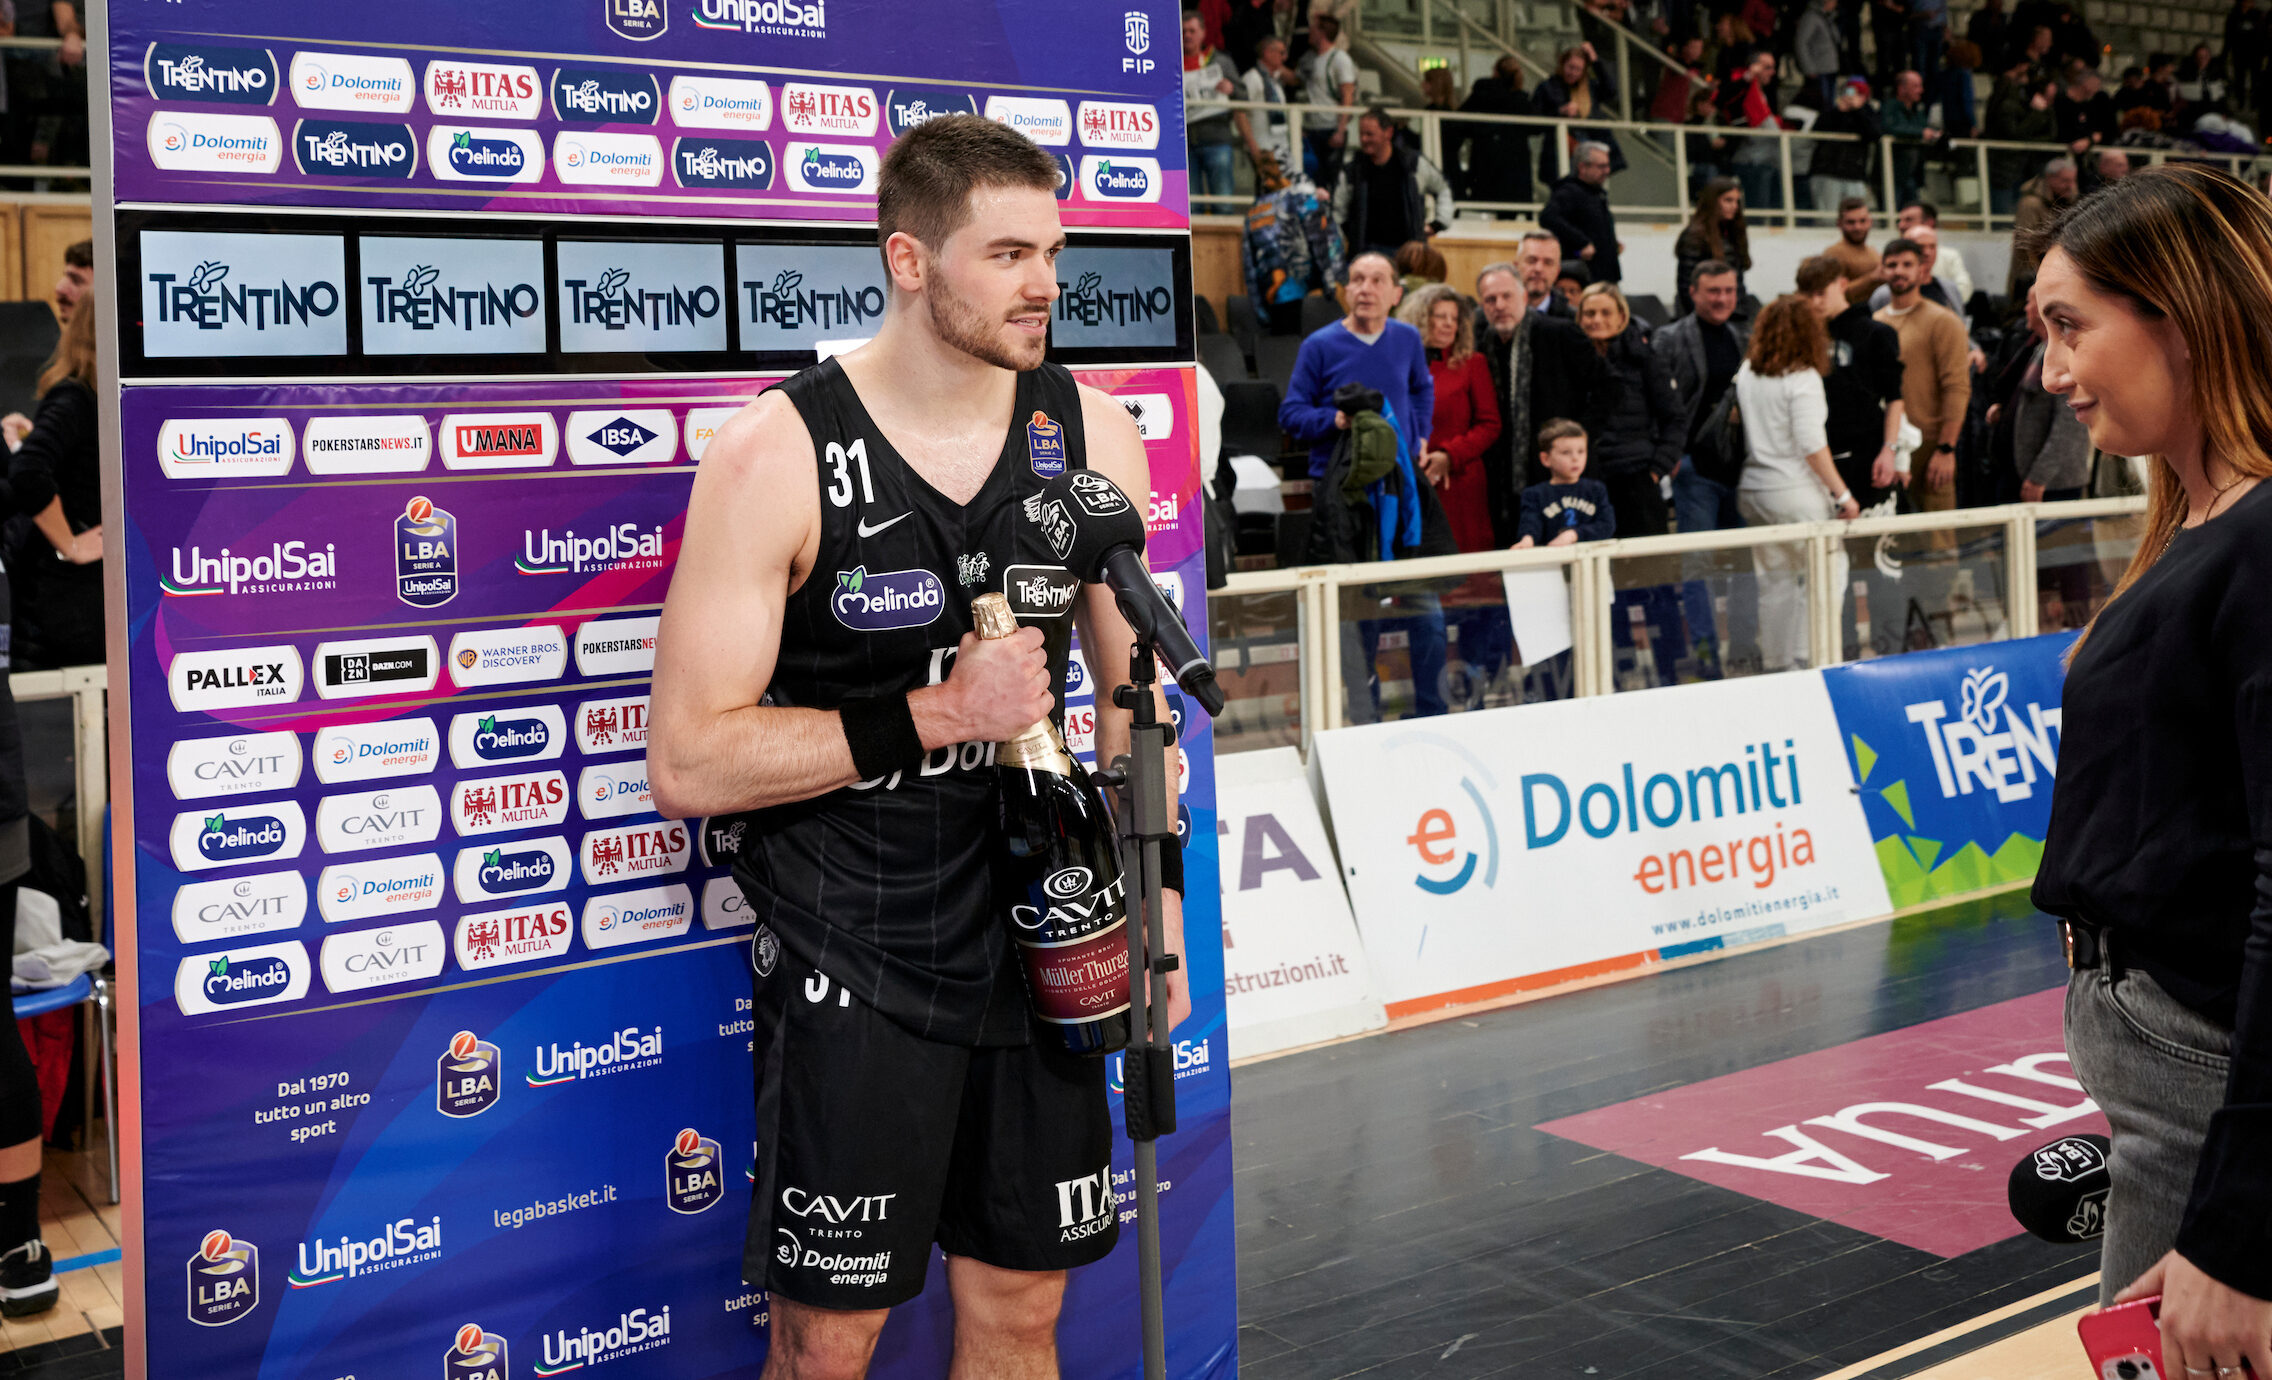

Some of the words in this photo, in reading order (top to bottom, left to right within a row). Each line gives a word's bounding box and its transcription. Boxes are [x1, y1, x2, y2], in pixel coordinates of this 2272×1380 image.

[615, 0, 660, 19] LBA
[701, 0, 825, 32] UnipolSai
[623, 19, 645, 28] SERIE
[754, 26, 826, 39] ASSICURAZIONI
[1122, 57, 1155, 74] FIP
[157, 59, 267, 93] TRENTINO
[332, 74, 402, 91] Dolomiti
[471, 72, 533, 99] ITAS
[355, 90, 401, 103] energia
[471, 99, 519, 112] MUTUA
[561, 84, 651, 114] TRENTINO
[704, 96, 762, 111] Dolomiti
[819, 93, 871, 118] ITAS
[723, 110, 761, 122] energia
[820, 118, 859, 129] MUTUA
[1014, 114, 1063, 127] Dolomiti
[1110, 110, 1153, 132] ITAS
[1030, 126, 1062, 137] energia
[1110, 133, 1143, 143] MUTUA
[192, 134, 268, 151] Dolomiti
[304, 136, 407, 167] TRENTINO
[217, 150, 267, 163] energia
[451, 146, 522, 166] Melinda
[590, 151, 652, 166] Dolomiti
[682, 152, 766, 180] TRENTINO
[610, 166, 651, 178] energia
[803, 161, 862, 180] Melinda
[1097, 171, 1146, 189] Melinda
[149, 273, 339, 331] TRENTINO
[367, 276, 539, 331] TRENTINO
[564, 279, 721, 331] TRENTINO
[743, 281, 885, 330] TRENTINO
[179, 431, 281, 462] UnipolSai
[312, 436, 423, 452] POKERSTARSNEWS.IT
[460, 428, 536, 452] UMANA
[601, 428, 645, 446] IBSA
[1033, 439, 1060, 450] LBA
[825, 438, 875, 508] 31
[1035, 461, 1062, 470] UnipolSai
[1085, 491, 1122, 506] LBA
[1052, 520, 1070, 550] LBA
[1147, 523, 1179, 532] RAZIONI
[404, 541, 450, 560] LBA
[525, 523, 663, 573] UnipolSai
[172, 540, 336, 594] UnipolSai
[413, 562, 434, 570] SERIE
[583, 559, 663, 573] ASSICURAZIONI
[242, 580, 336, 594] ASSICURAZIONI
[405, 578, 451, 595] UnipolSai
[1016, 581, 1075, 608] TRENTINO
[838, 582, 939, 614] Melinda
[482, 645, 530, 657] WARNER
[531, 642, 561, 654] BROS.
[347, 658, 364, 669] DA
[372, 659, 413, 671] DAZN.COM
[482, 654, 542, 668] DISCOVERY
[187, 663, 286, 691] PALLEX
[347, 669, 364, 680] ZN
[256, 687, 287, 697] ITALIA
[476, 724, 547, 750] Melinda
[622, 730, 648, 743] MUT
[359, 738, 429, 757] Dolomiti
[1904, 700, 2062, 803] TREN
[194, 755, 285, 780] CAVIT
[382, 752, 428, 766] energia
[220, 781, 262, 791] TRENTO
[500, 778, 563, 810] ITAS
[1521, 739, 1802, 850] Dolomiti
[341, 808, 425, 834] CAVIT
[501, 807, 549, 823] MUTUA
[202, 826, 282, 850] Melinda
[365, 834, 405, 845] TRENTO
[626, 827, 686, 858] ITAS
[627, 855, 673, 872] MUTUA
[1633, 822, 1816, 895] energia
[481, 856, 552, 884] Melinda
[362, 873, 434, 895] Dolomiti
[385, 888, 432, 903] energia
[1011, 871, 1126, 930] CAVIT
[198, 895, 289, 923] CAVIT
[622, 902, 685, 924] Dolomiti
[1651, 885, 1840, 936] www.dolomitienergia.it
[223, 922, 266, 934] TRENTO
[504, 909, 567, 943] ITAS
[641, 915, 683, 931] energia
[1045, 912, 1114, 938] TRENTO
[504, 939, 552, 956] MUTUA
[1058, 951, 1095, 963] SPUMANTE
[1098, 943, 1114, 954] BRUT
[345, 944, 428, 973] CAVIT
[1040, 966, 1084, 987] Müller
[1083, 949, 1129, 982] Thurga
[207, 965, 287, 994] Melinda
[368, 971, 408, 983] TRENTO
[1073, 983, 1096, 993] DELLE
[1099, 968, 1130, 986] DOLOMIT
[735, 998, 753, 1012] Da
[1079, 988, 1116, 1006] CAVIT
[719, 1020, 755, 1037] tutto
[536, 1025, 662, 1079] UnipolSai
[588, 1058, 662, 1078] ASSICURAZIONI
[1173, 1065, 1210, 1081] CURAZIONI
[278, 1078, 305, 1098] Dal
[309, 1071, 350, 1091] 1970
[446, 1074, 493, 1099] LBA
[254, 1105, 300, 1124] tutto
[304, 1099, 326, 1116] un
[330, 1092, 371, 1110] altro
[454, 1096, 476, 1107] SERIE
[290, 1119, 336, 1143] sport
[2058, 1142, 2092, 1168] LBA
[675, 1170, 717, 1195] LBA
[683, 1192, 702, 1203] SERIE
[782, 1187, 897, 1224] CAVIT
[1054, 1164, 1115, 1228] ITA
[494, 1184, 617, 1229] legabasket.it
[808, 1227, 862, 1239] TRENTO
[299, 1216, 441, 1278] UnipolSai
[359, 1250, 441, 1275] ASSICURAZIONI
[802, 1250, 892, 1271] Dolomiti
[829, 1271, 888, 1288] energia
[198, 1277, 251, 1306] LBA
[207, 1302, 232, 1314] SERIE
[233, 1300, 241, 1309] A
[724, 1292, 761, 1312] tutto
[543, 1305, 670, 1366] UnipolSai
[597, 1337, 670, 1363] ASSICURAZIONI
